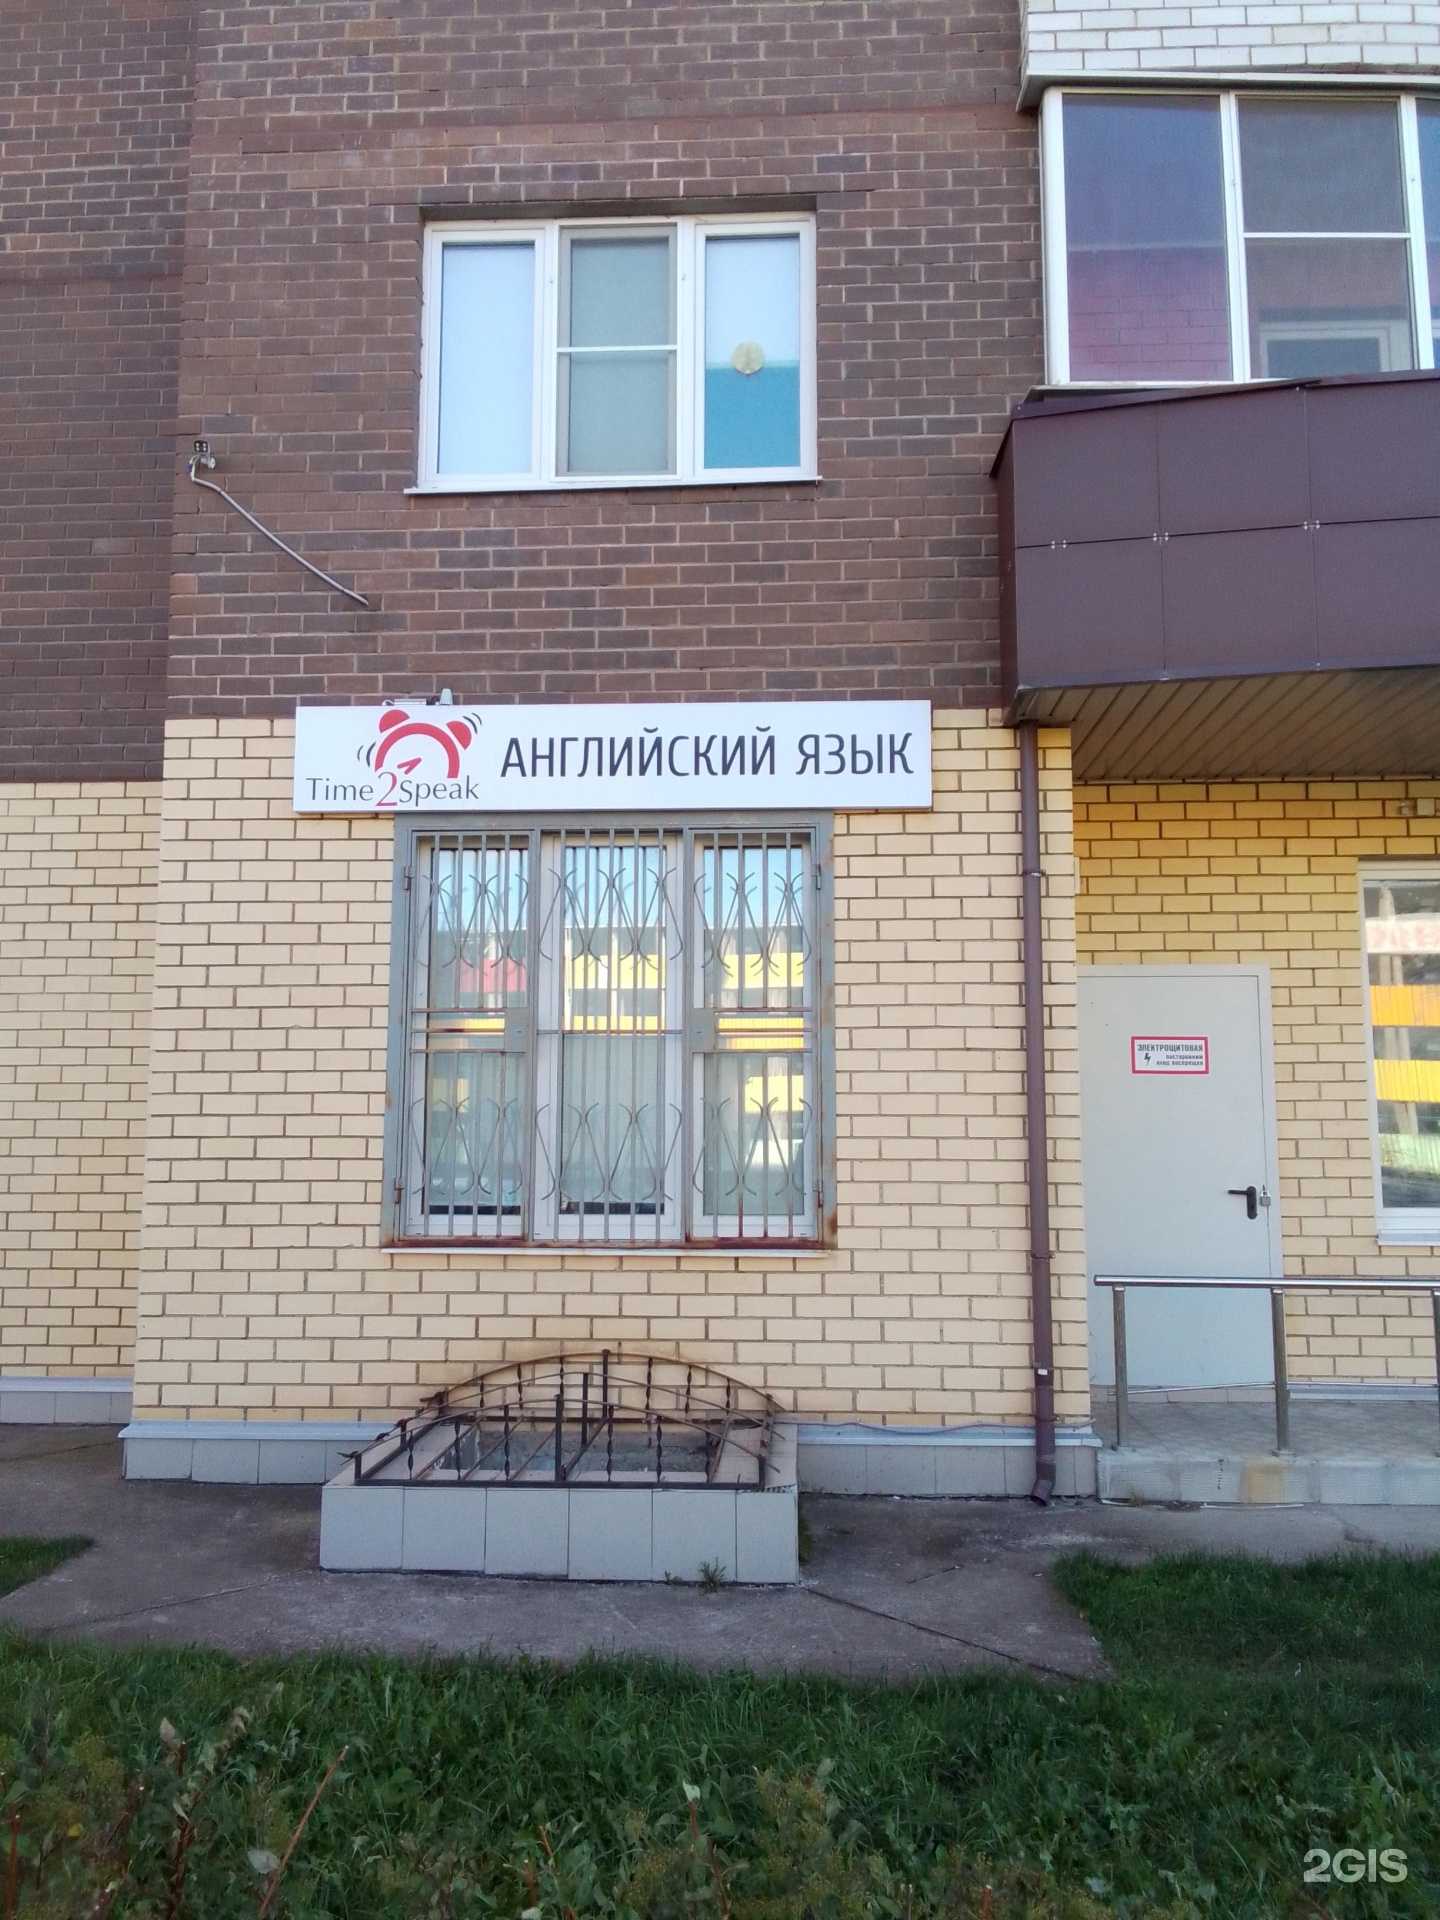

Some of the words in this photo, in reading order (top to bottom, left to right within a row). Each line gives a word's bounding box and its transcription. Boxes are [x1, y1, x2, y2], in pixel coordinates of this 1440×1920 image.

[500, 726, 776, 777] АНГЛИЙСКИЙ
[795, 732, 914, 775] ЯЗЫК
[306, 771, 480, 807] Time2Speak
[1137, 1044, 1203, 1052] ЭЛЕКТРОЩИТОВАЯ
